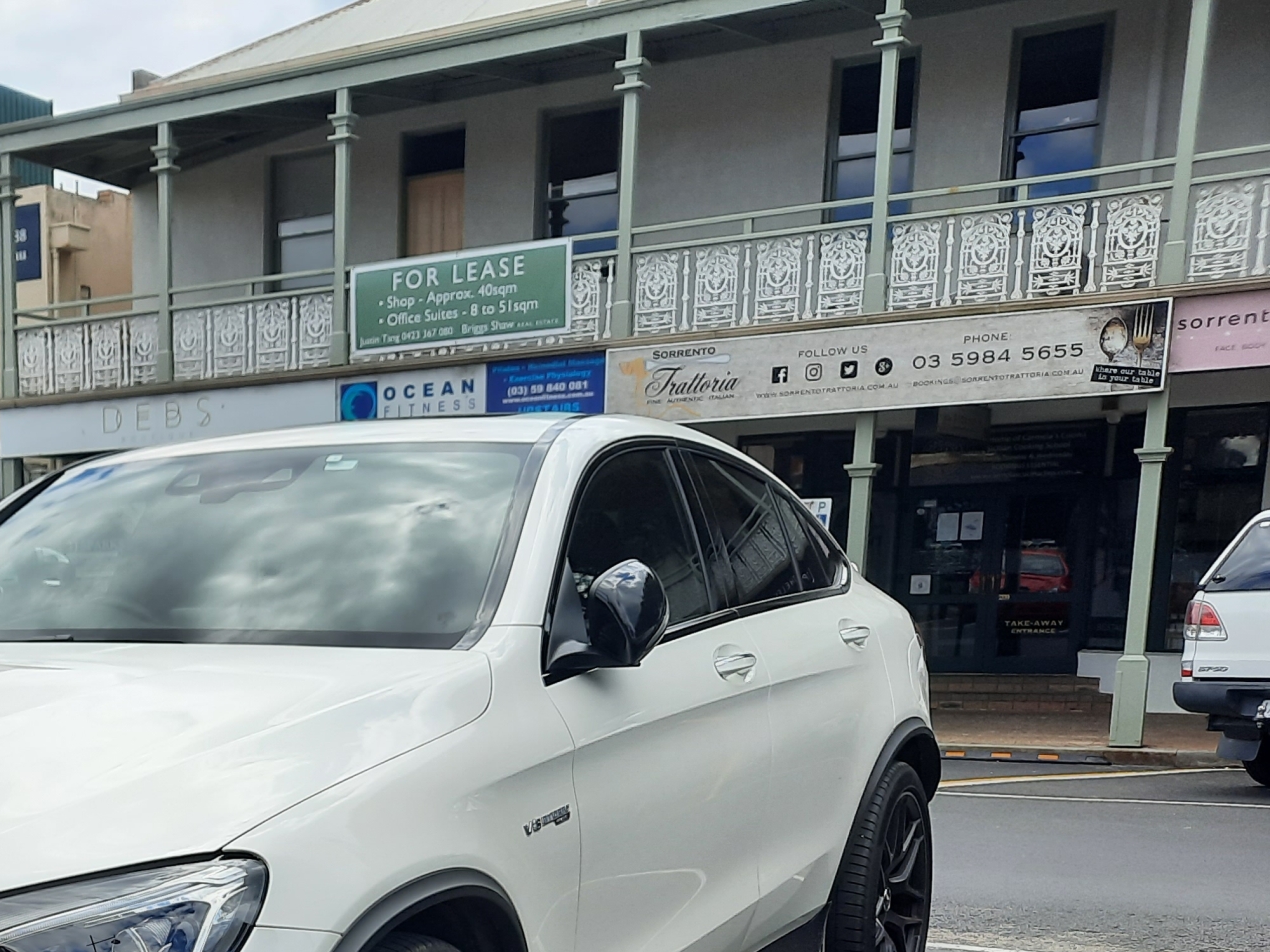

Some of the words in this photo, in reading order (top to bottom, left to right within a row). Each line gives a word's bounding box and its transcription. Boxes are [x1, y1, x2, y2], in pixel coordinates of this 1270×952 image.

[392, 267, 439, 291] FOR
[452, 255, 526, 284] LEASE
[386, 295, 415, 310] Shop
[427, 291, 475, 306] Approx.
[478, 282, 517, 299] 40sqm
[387, 312, 421, 326] Office
[424, 308, 458, 322] Suites
[470, 304, 478, 316] 8
[481, 301, 495, 315] to
[499, 299, 538, 316] 51sqm
[461, 323, 488, 335] Briggs
[491, 320, 515, 330] Shaw
[963, 332, 1012, 344] PHONE:
[652, 347, 716, 360] SORRENTO
[798, 347, 848, 358] FOLLOW
[852, 345, 868, 354] US
[912, 354, 941, 370] 03
[951, 349, 1011, 366] 5984
[1022, 343, 1083, 361] 5655
[546, 370, 592, 381] Physiology
[645, 365, 739, 398] Trattoria
[1109, 375, 1129, 383] your
[1132, 376, 1154, 384] table
[383, 378, 474, 401] OCEAN
[507, 386, 527, 398] (03)
[531, 384, 544, 394] 59
[546, 382, 566, 392] 840
[569, 381, 588, 391] 081
[102, 396, 211, 434] DEBS
[384, 398, 476, 418] FITNESS
